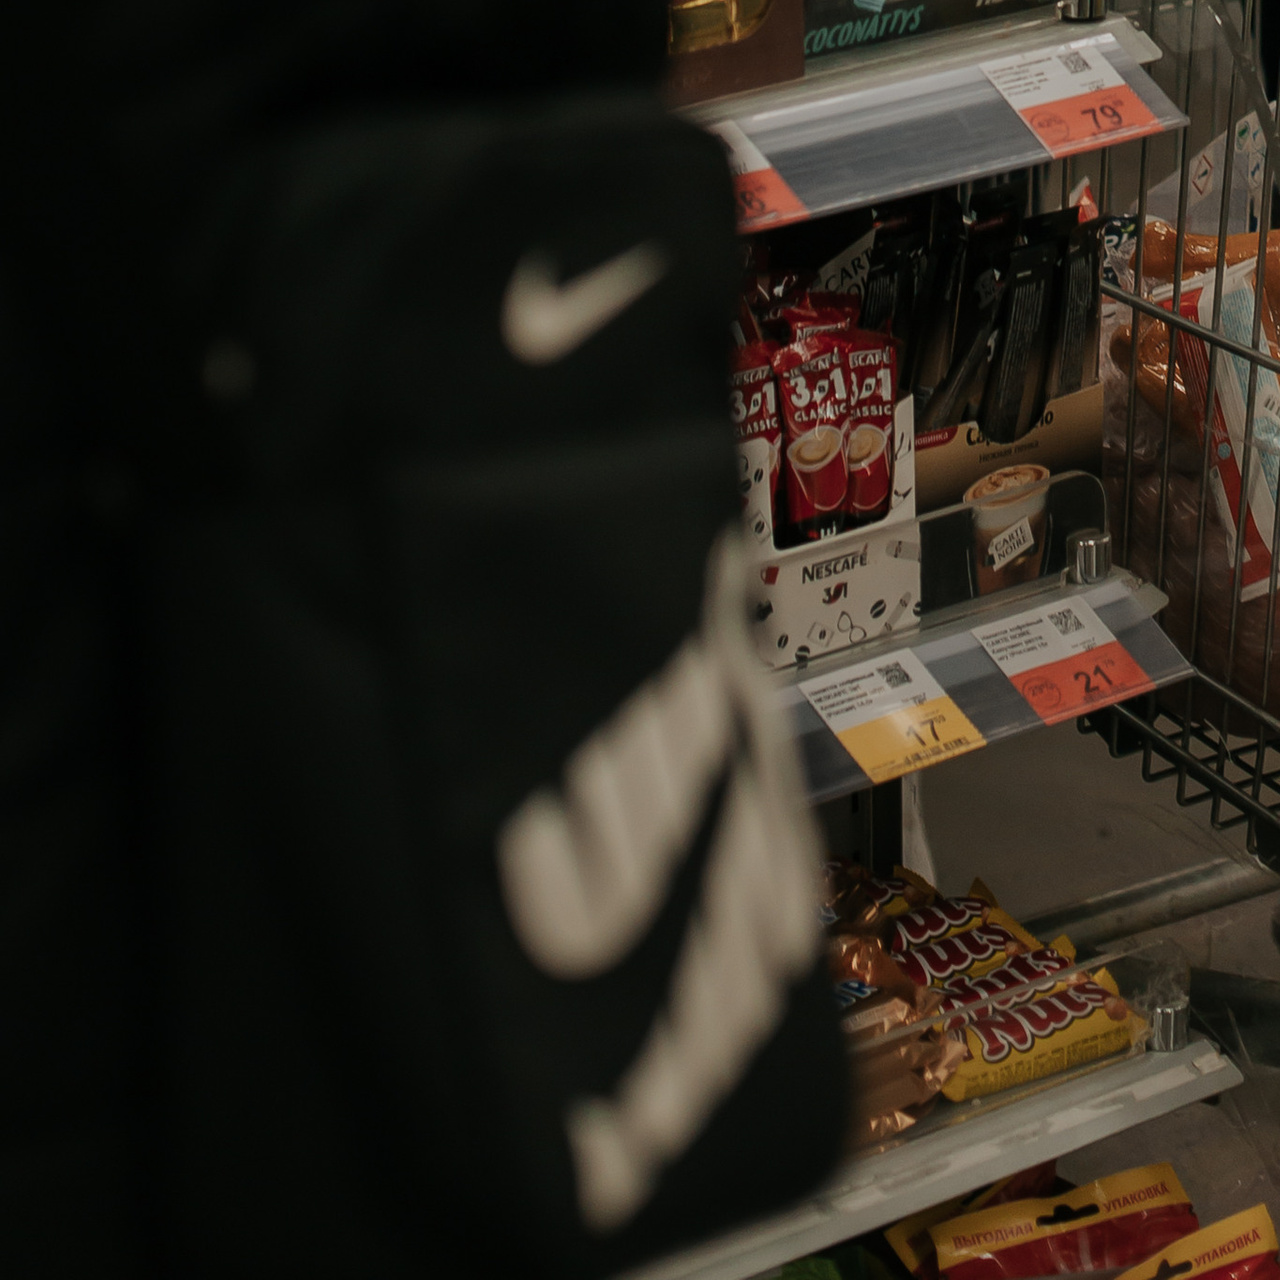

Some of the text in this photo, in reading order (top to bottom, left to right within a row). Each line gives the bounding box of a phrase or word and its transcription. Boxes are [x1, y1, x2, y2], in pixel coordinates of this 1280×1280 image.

[803, 4, 925, 54] COCONATTYS
[995, 526, 1026, 551] CARTE
[998, 536, 1028, 561] NOIRE
[802, 543, 868, 584] NESCAFÉ
[1073, 664, 1113, 694] 21
[969, 981, 1114, 1063] Nuts
[953, 1181, 1170, 1250] ВЫГОДНАЯ УПАКОВКА
[1194, 1228, 1261, 1267] УПАКОВКА
